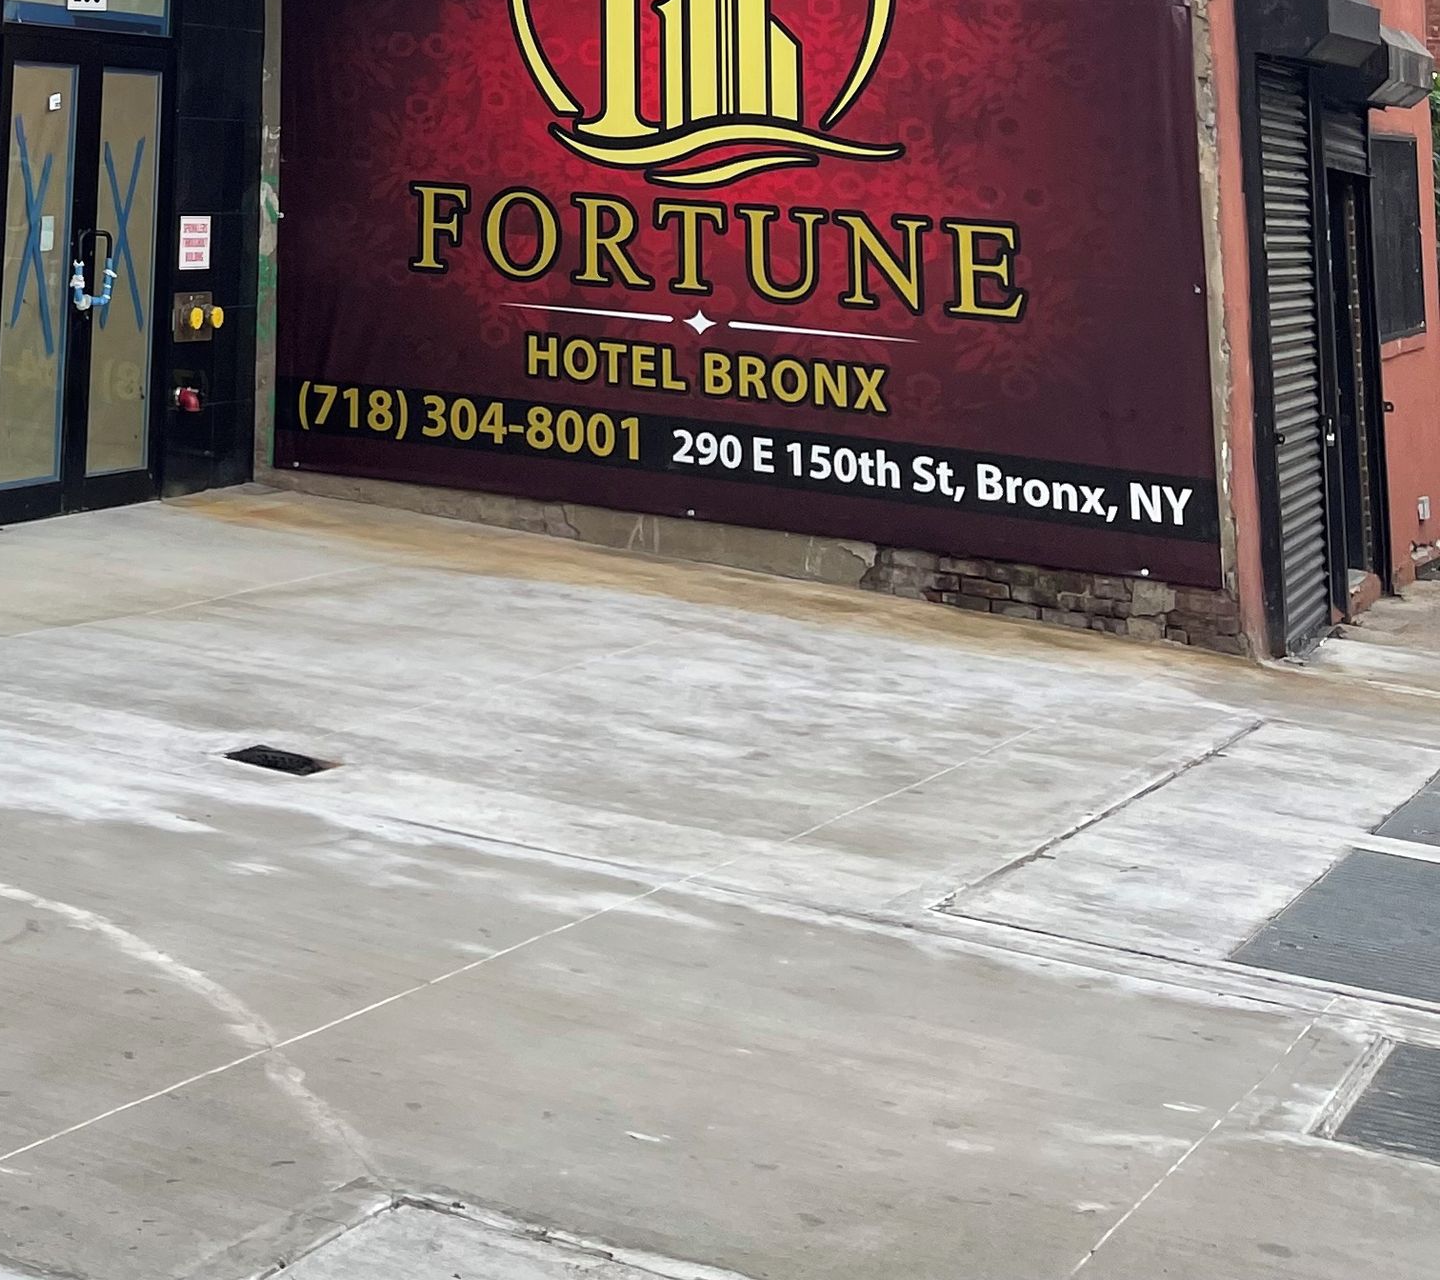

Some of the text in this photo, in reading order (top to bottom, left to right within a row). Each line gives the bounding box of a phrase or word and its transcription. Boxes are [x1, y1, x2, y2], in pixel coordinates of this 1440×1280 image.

[412, 184, 1025, 320] FORTUNE
[526, 333, 889, 414] HOTEL BRONX
[298, 380, 640, 461] (718) 304-8001
[671, 428, 1194, 527] 290 E 150th St, Bronx, NY
